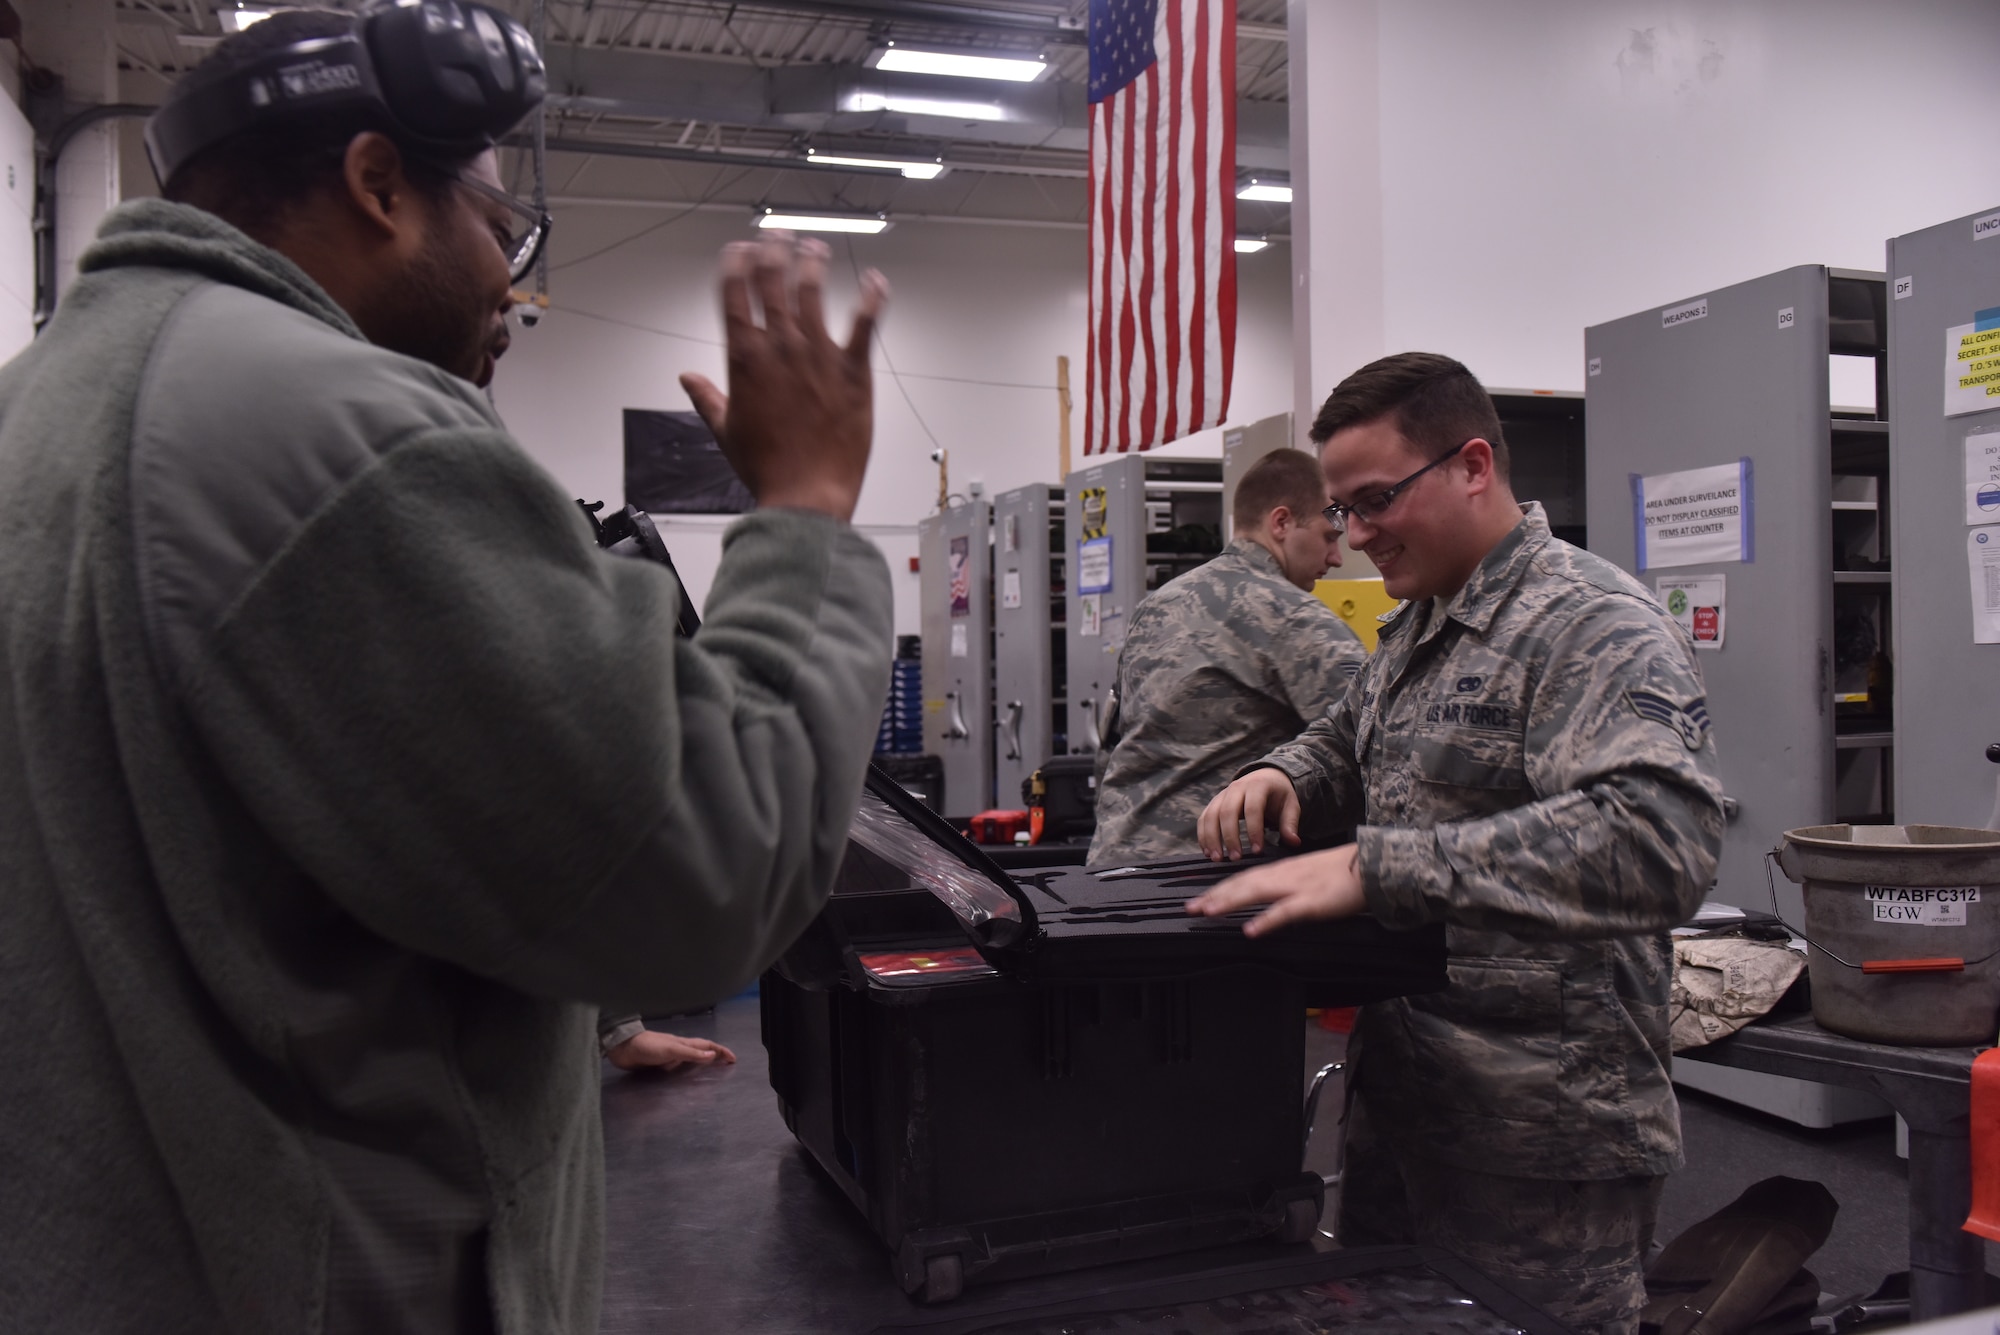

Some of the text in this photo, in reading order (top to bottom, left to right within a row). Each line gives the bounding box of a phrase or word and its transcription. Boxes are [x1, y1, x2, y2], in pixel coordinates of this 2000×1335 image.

[1975, 217, 2000, 233] UNC
[1897, 282, 1909, 293] DF
[1663, 306, 1706, 325] WEAPONS 2
[1780, 313, 1792, 323] DG
[1960, 337, 1974, 346] ALL
[1957, 347, 1988, 360] SECRET,
[1646, 488, 1737, 509] AREA UNDER SURVEILANCE
[1645, 505, 1739, 525] DO NOT DISPLAY CLASSIFIED
[1659, 522, 1724, 538] ITEMS AT COUNTER
[1441, 704, 1461, 724] AIR
[1463, 705, 1510, 727] FORCE
[1867, 886, 1976, 902] WTABFC312
[1876, 905, 1922, 920] EGW
